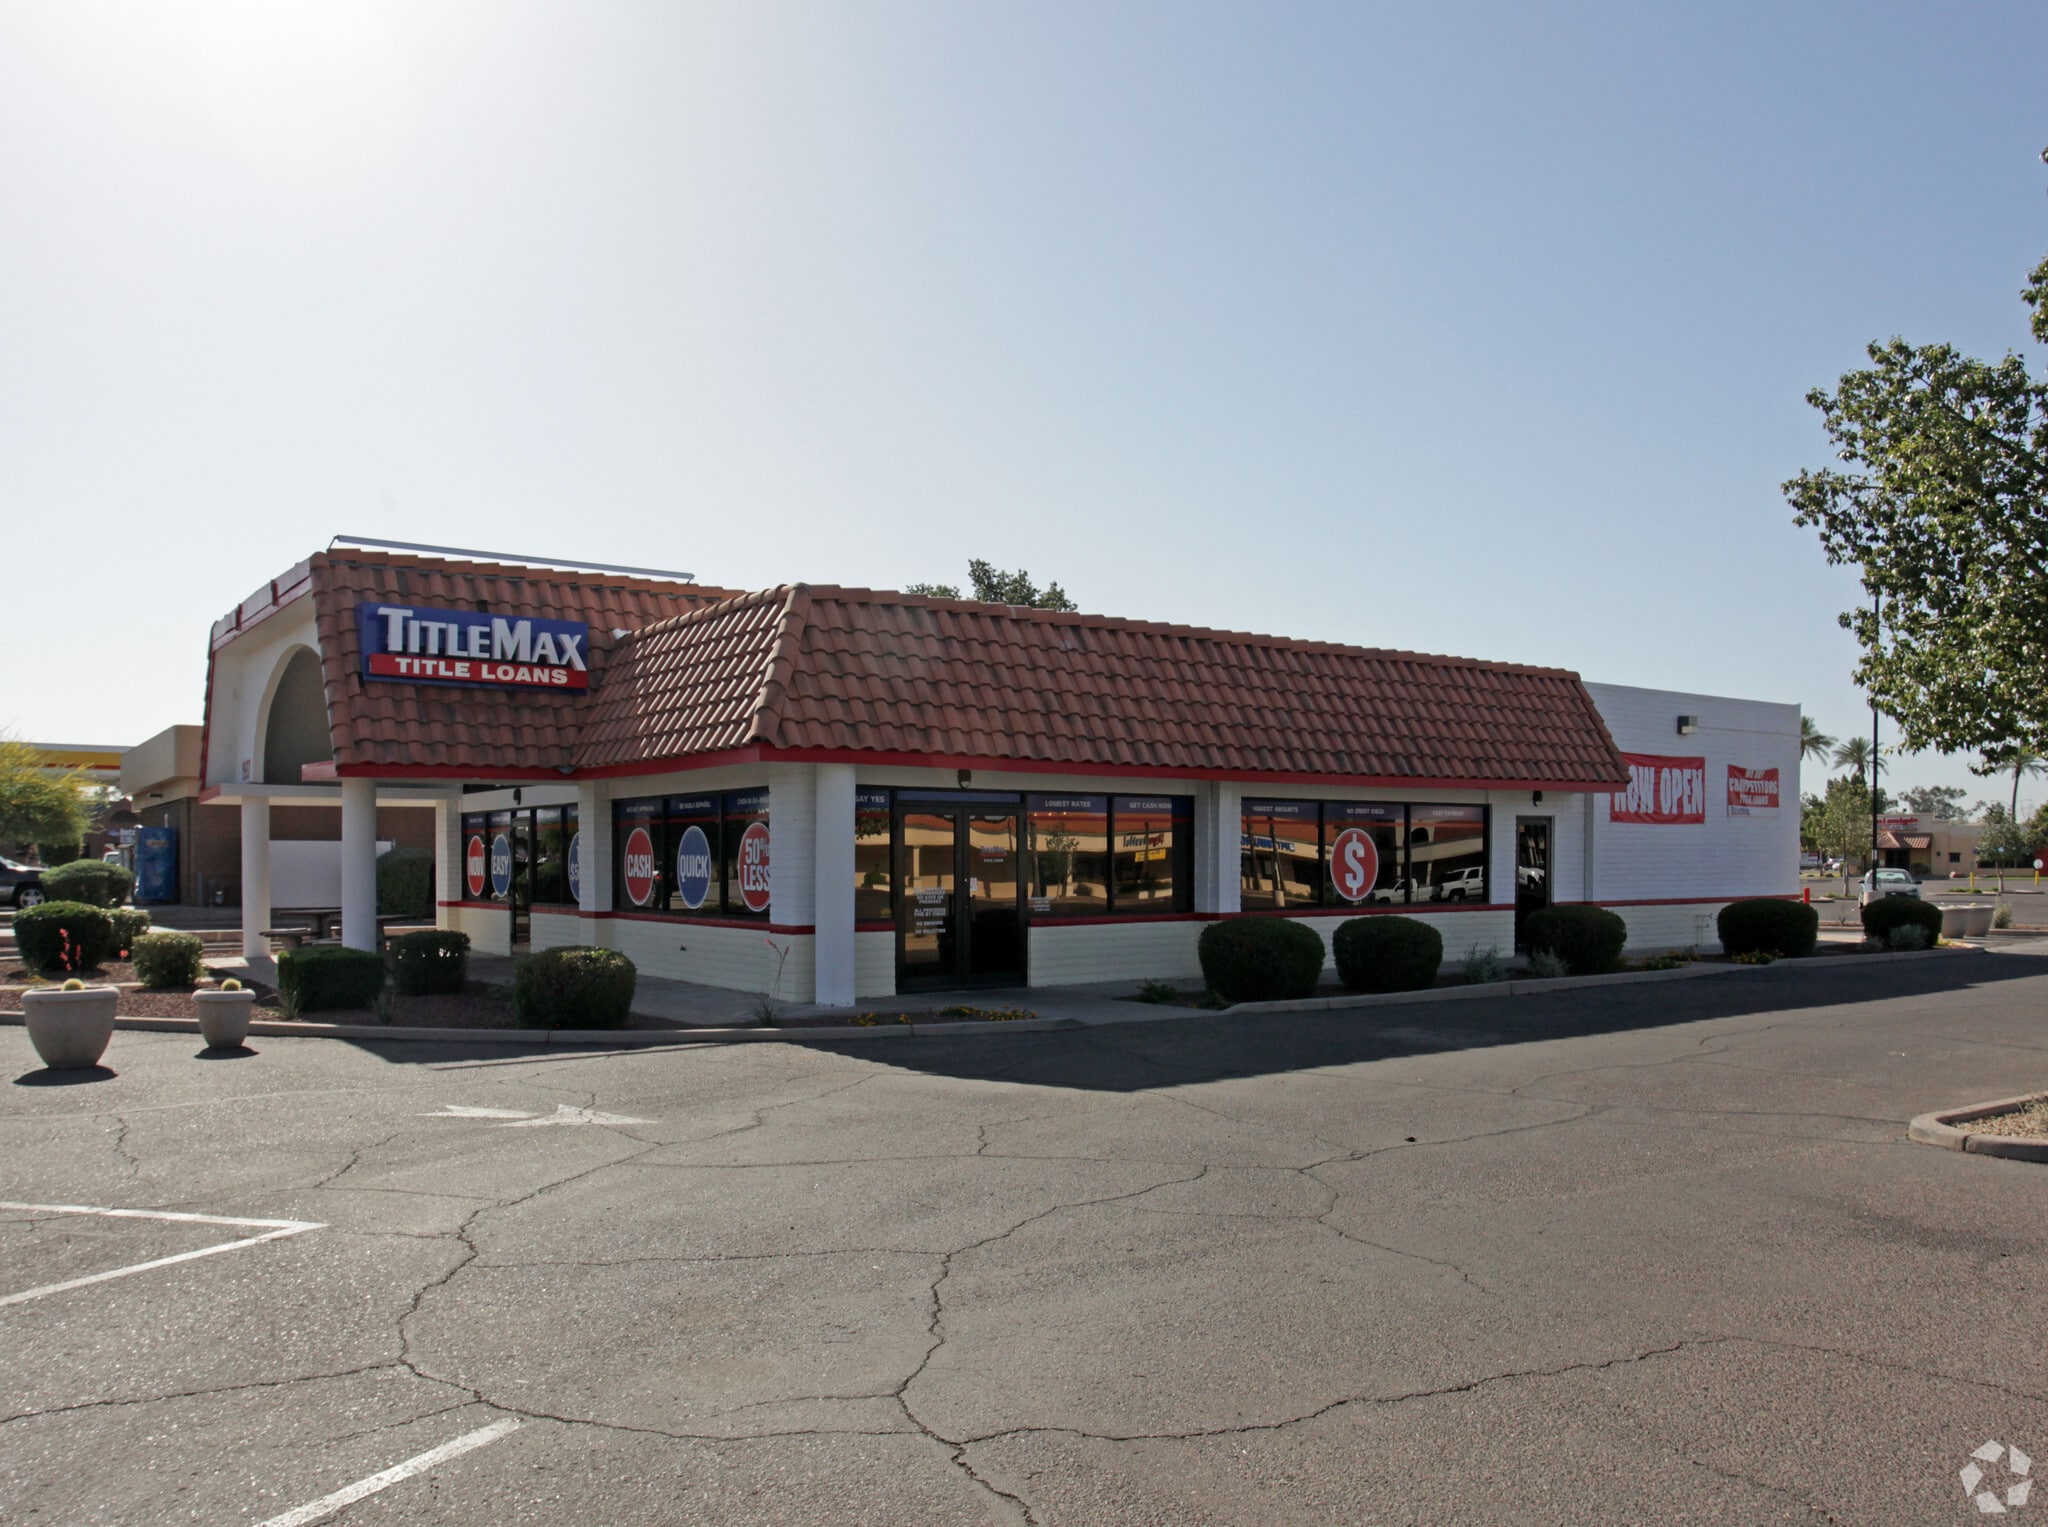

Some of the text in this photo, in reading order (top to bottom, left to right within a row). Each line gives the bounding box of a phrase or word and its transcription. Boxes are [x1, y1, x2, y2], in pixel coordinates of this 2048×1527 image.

[395, 657, 568, 685] TITLE LOANS
[870, 795, 885, 803] YES
[1659, 766, 1703, 815] OPEN
[493, 855, 509, 876] EASY
[627, 854, 651, 878] CASH
[679, 854, 708, 882] QUICK
